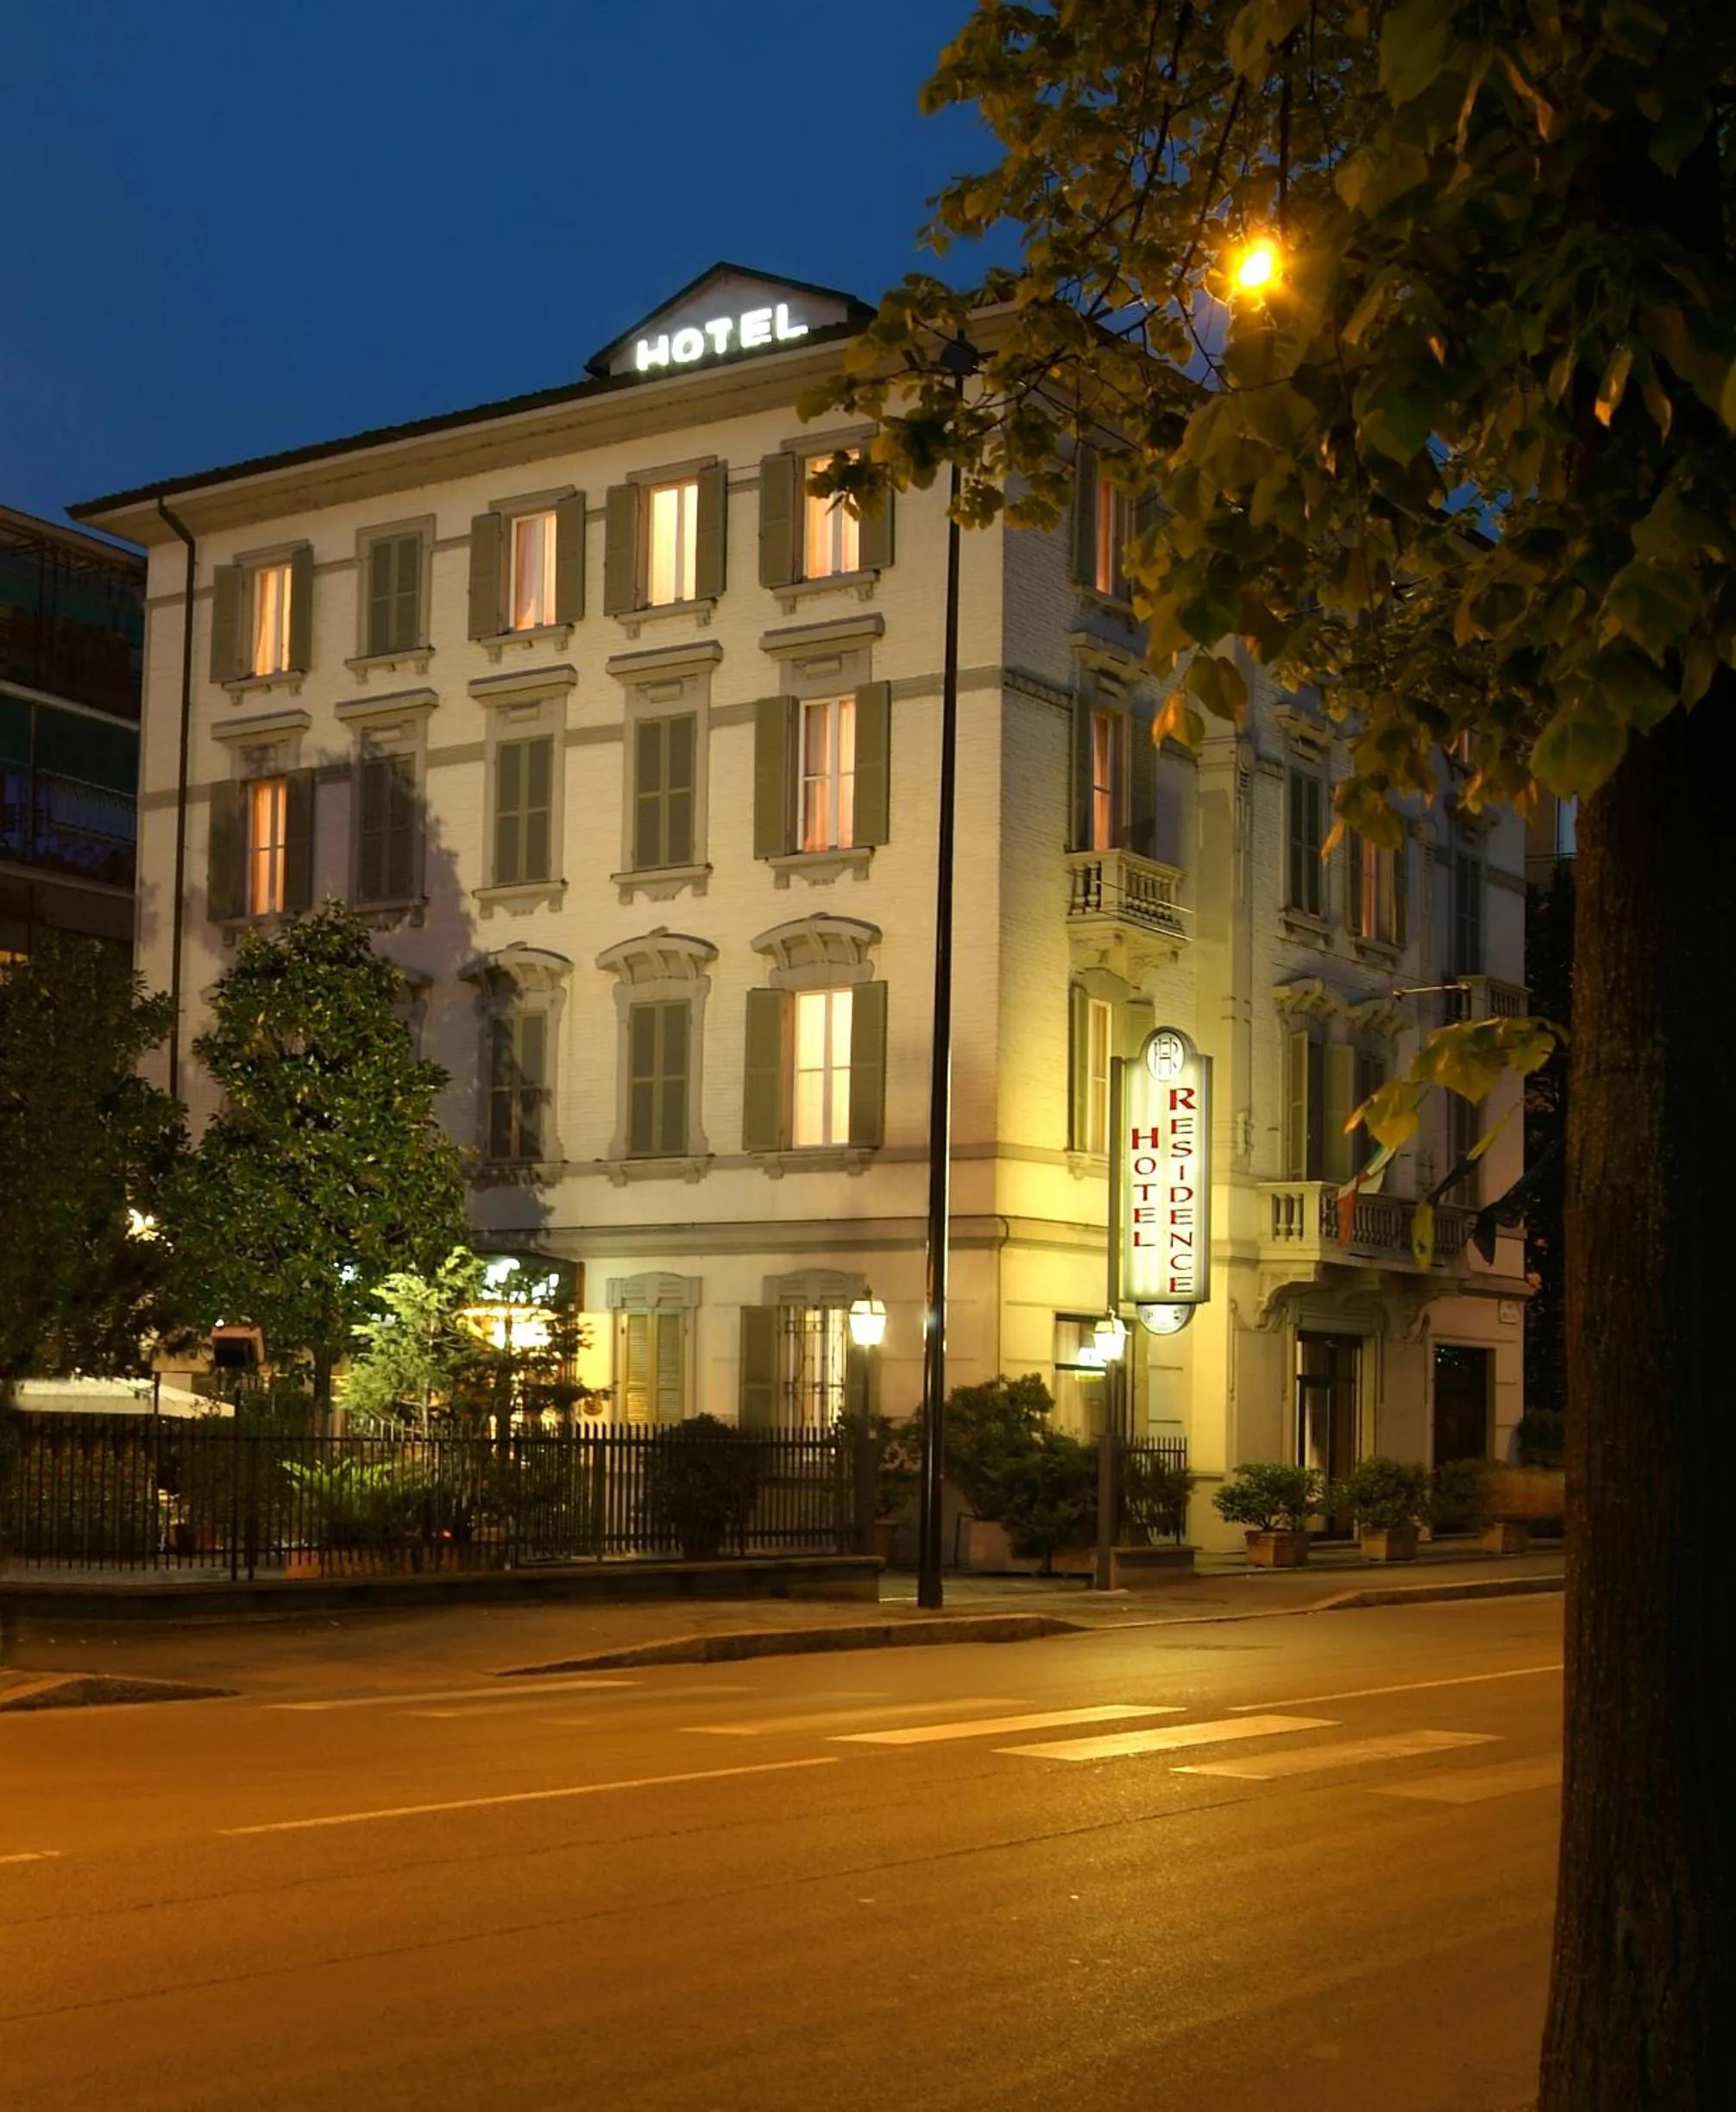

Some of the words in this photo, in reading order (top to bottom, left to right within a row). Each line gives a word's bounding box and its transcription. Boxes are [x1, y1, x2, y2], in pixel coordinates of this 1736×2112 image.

[636, 303, 808, 371] HOTEL
[1131, 1127, 1159, 1247] HOTEL
[1169, 1087, 1197, 1293] RESIDENCE
